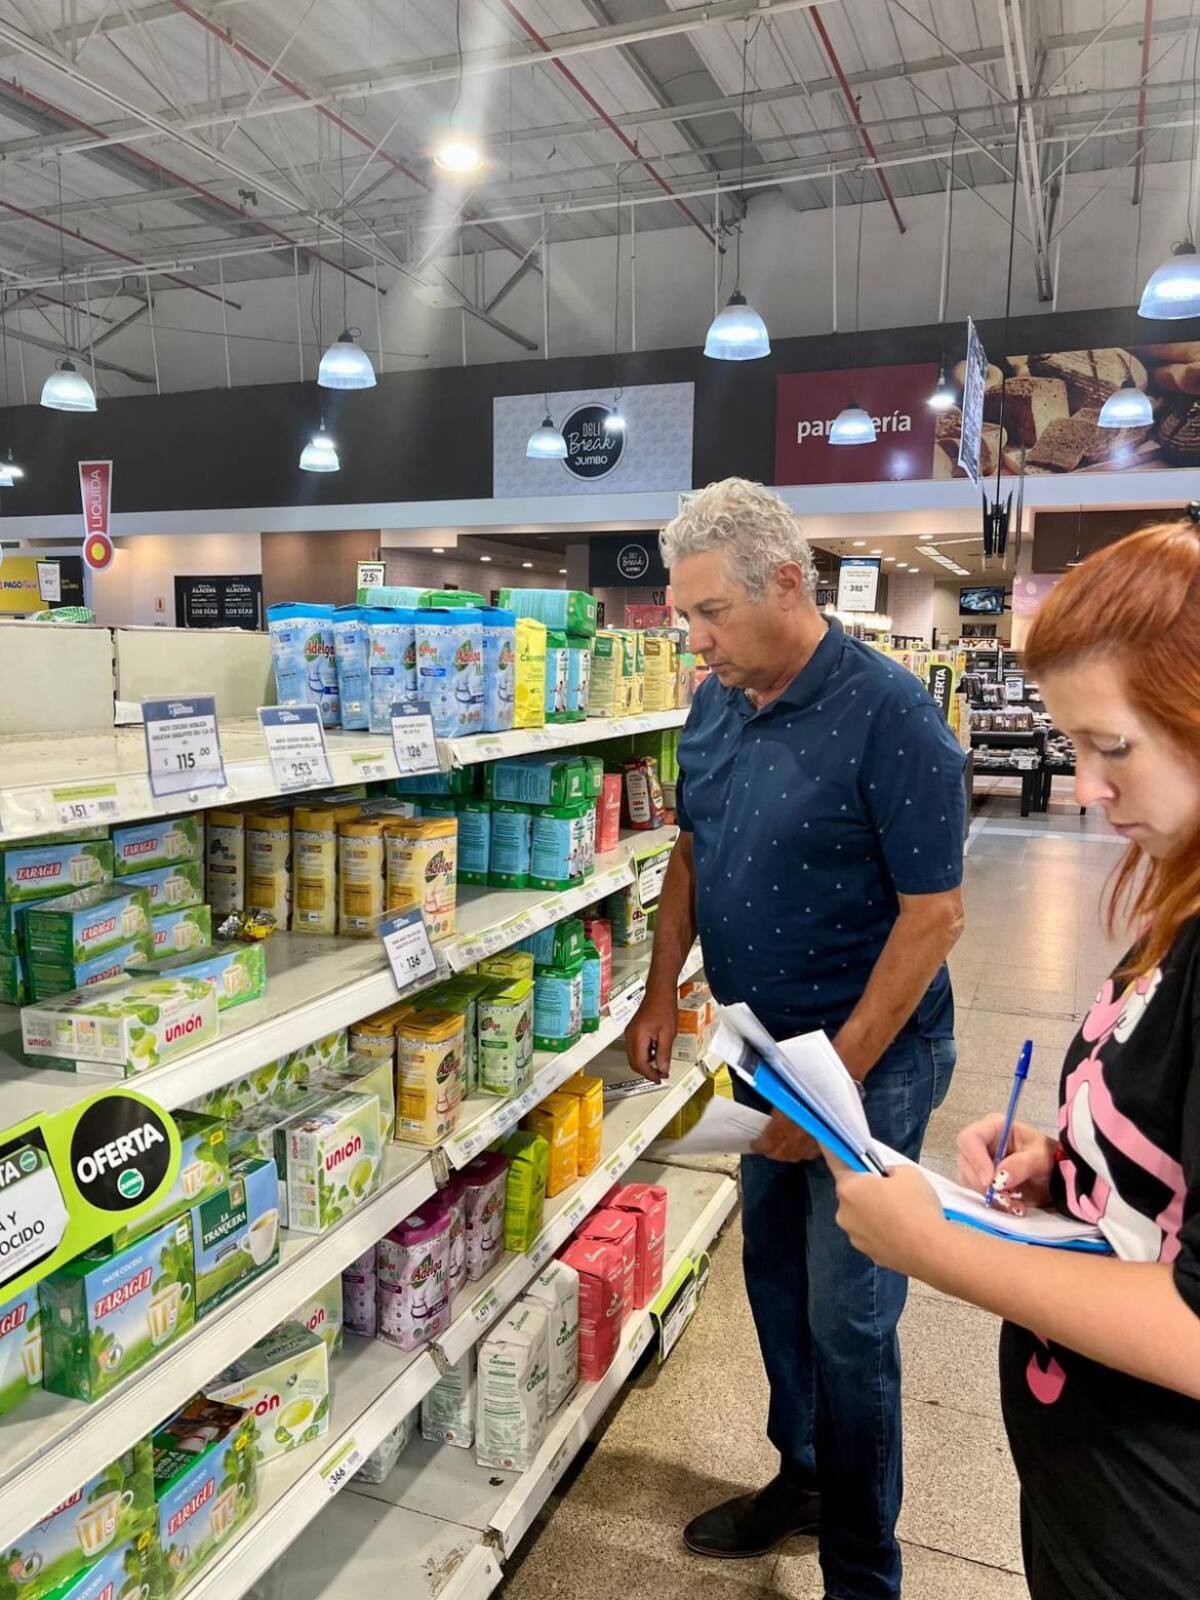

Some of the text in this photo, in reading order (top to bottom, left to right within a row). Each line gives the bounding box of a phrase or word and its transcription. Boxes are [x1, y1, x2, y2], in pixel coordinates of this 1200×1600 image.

[797, 410, 912, 444] panería
[568, 432, 616, 455] Break
[574, 456, 608, 466] JUMBO
[91, 469, 103, 528] LIQUIDA
[176, 752, 195, 769] 115
[70, 804, 87, 818] 151
[406, 954, 421, 970] 136
[77, 1123, 164, 1184] OFERTA
[204, 1211, 246, 1245] TRANQUERA
[220, 1212, 228, 1222] LA
[0, 1220, 44, 1256] OCIDO
[412, 1258, 442, 1280] Adelga
